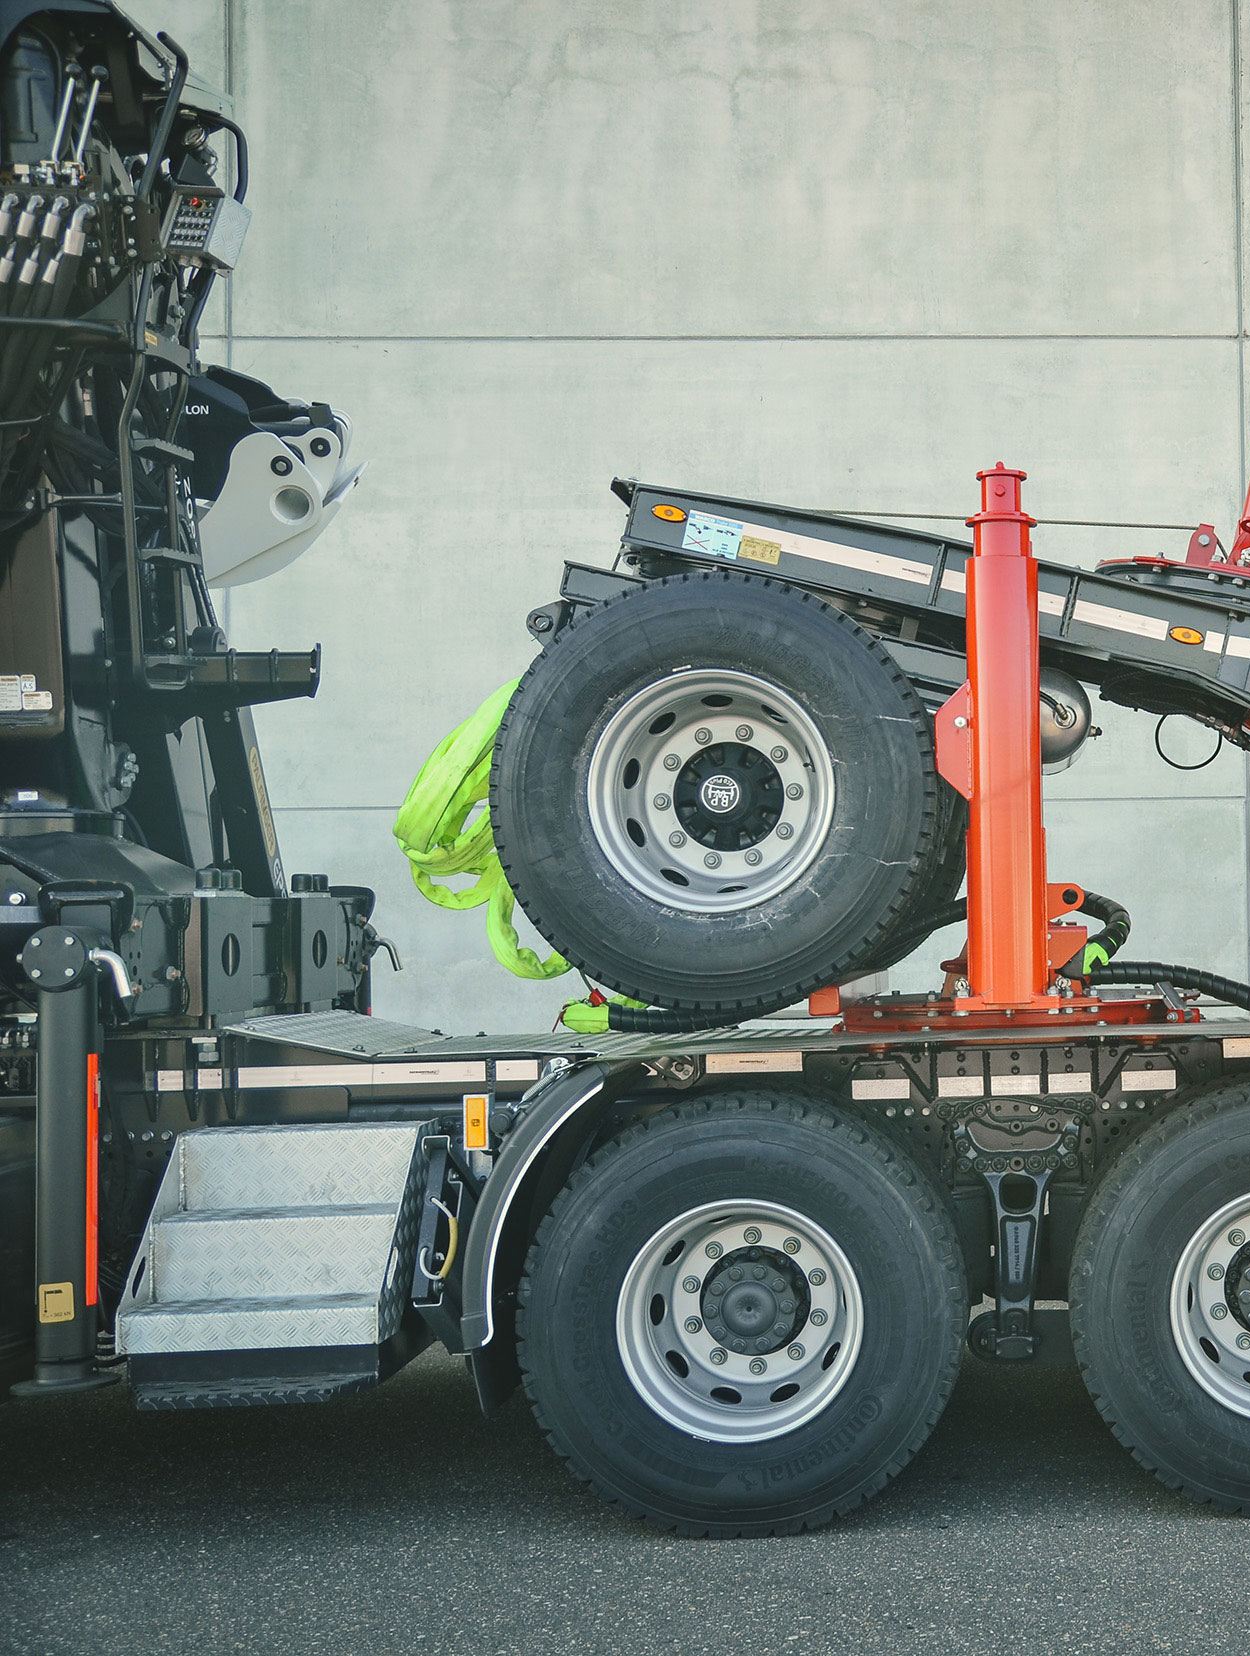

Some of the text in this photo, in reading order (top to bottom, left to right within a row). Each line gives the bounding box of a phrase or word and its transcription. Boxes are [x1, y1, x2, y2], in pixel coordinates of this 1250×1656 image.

[185, 405, 210, 415] LON
[571, 1246, 603, 1371] CrossTrac
[594, 1198, 638, 1245] HD3
[1127, 1274, 1183, 1416] Continental
[762, 1394, 884, 1489] Continental
